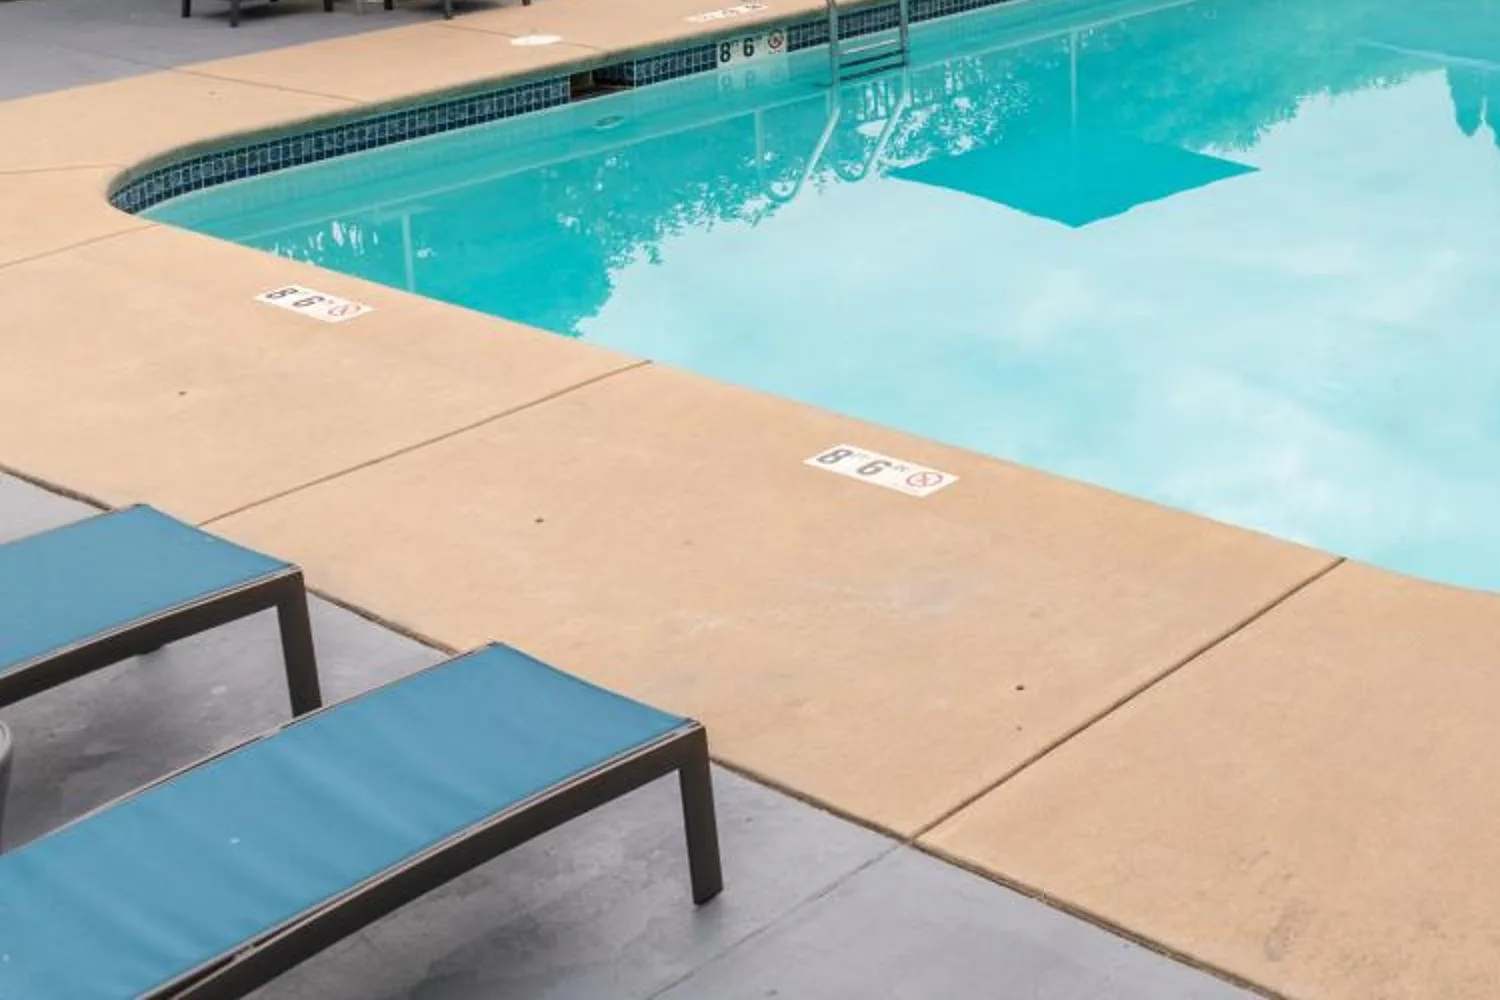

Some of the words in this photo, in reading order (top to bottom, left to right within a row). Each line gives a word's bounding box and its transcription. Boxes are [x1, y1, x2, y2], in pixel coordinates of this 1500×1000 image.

[720, 42, 731, 62] 8
[743, 37, 754, 57] 6
[266, 288, 298, 299] 8
[293, 296, 324, 307] 6
[816, 449, 853, 465] 8
[857, 460, 892, 476] 6
